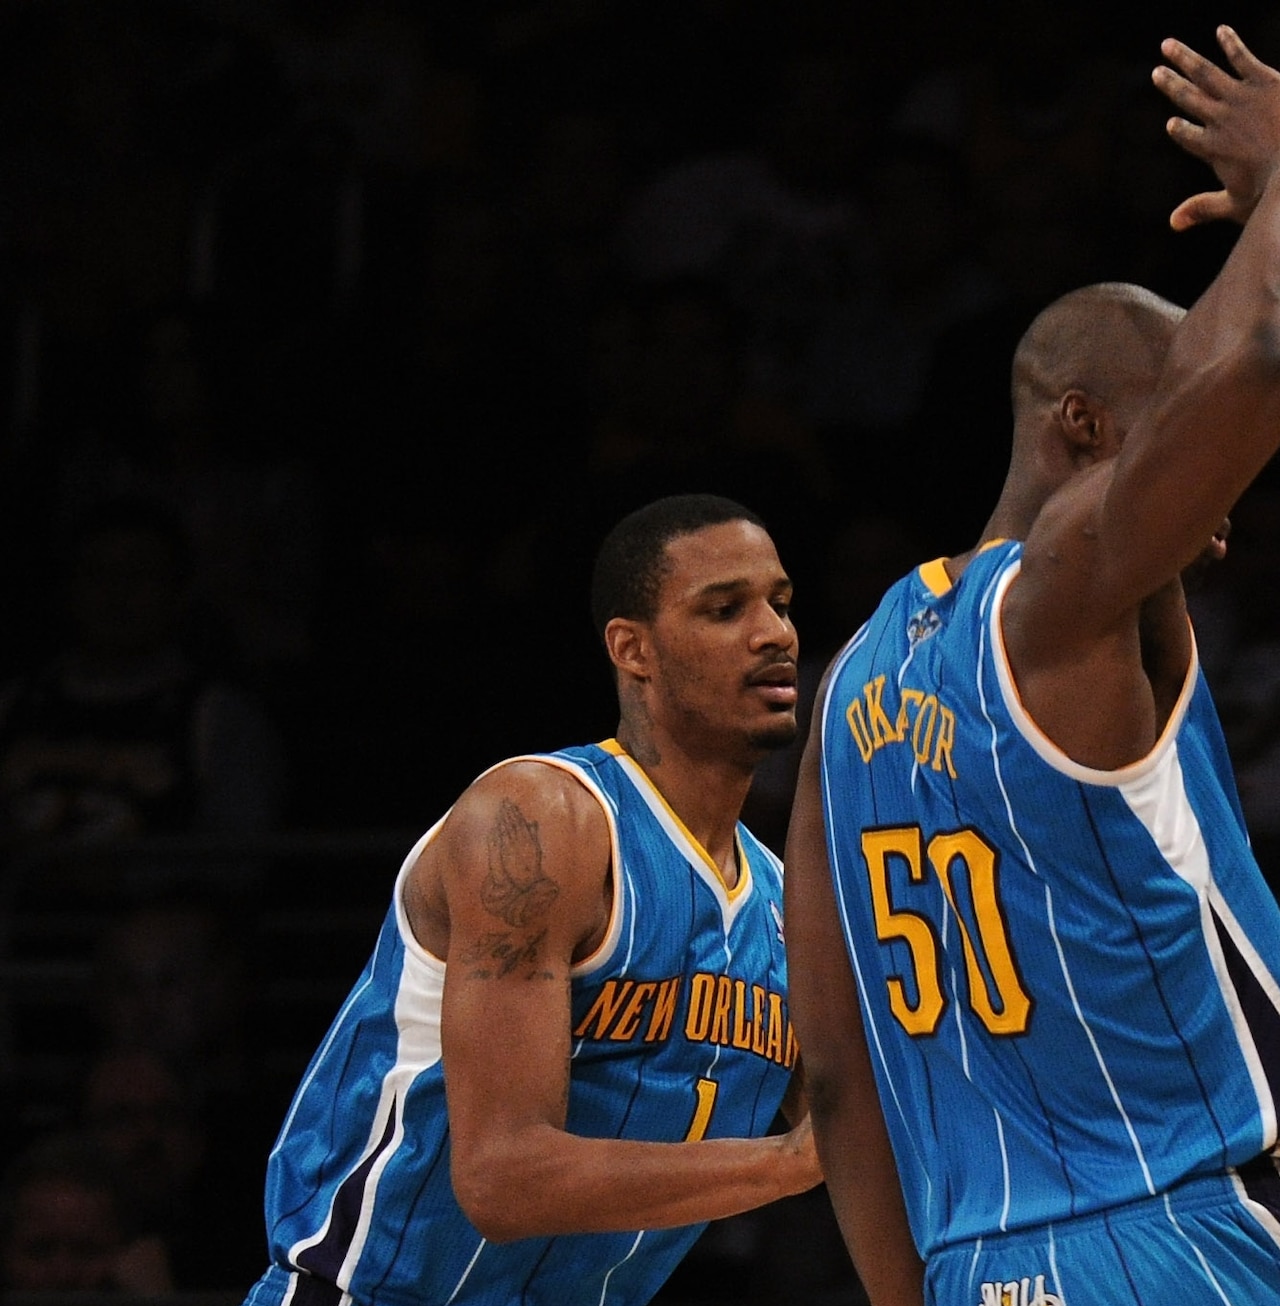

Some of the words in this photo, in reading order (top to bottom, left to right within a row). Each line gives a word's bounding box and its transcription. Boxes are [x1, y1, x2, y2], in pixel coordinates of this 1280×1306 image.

[845, 674, 957, 779] OKFOR
[860, 823, 1034, 1036] 50
[573, 973, 683, 1042] NEW
